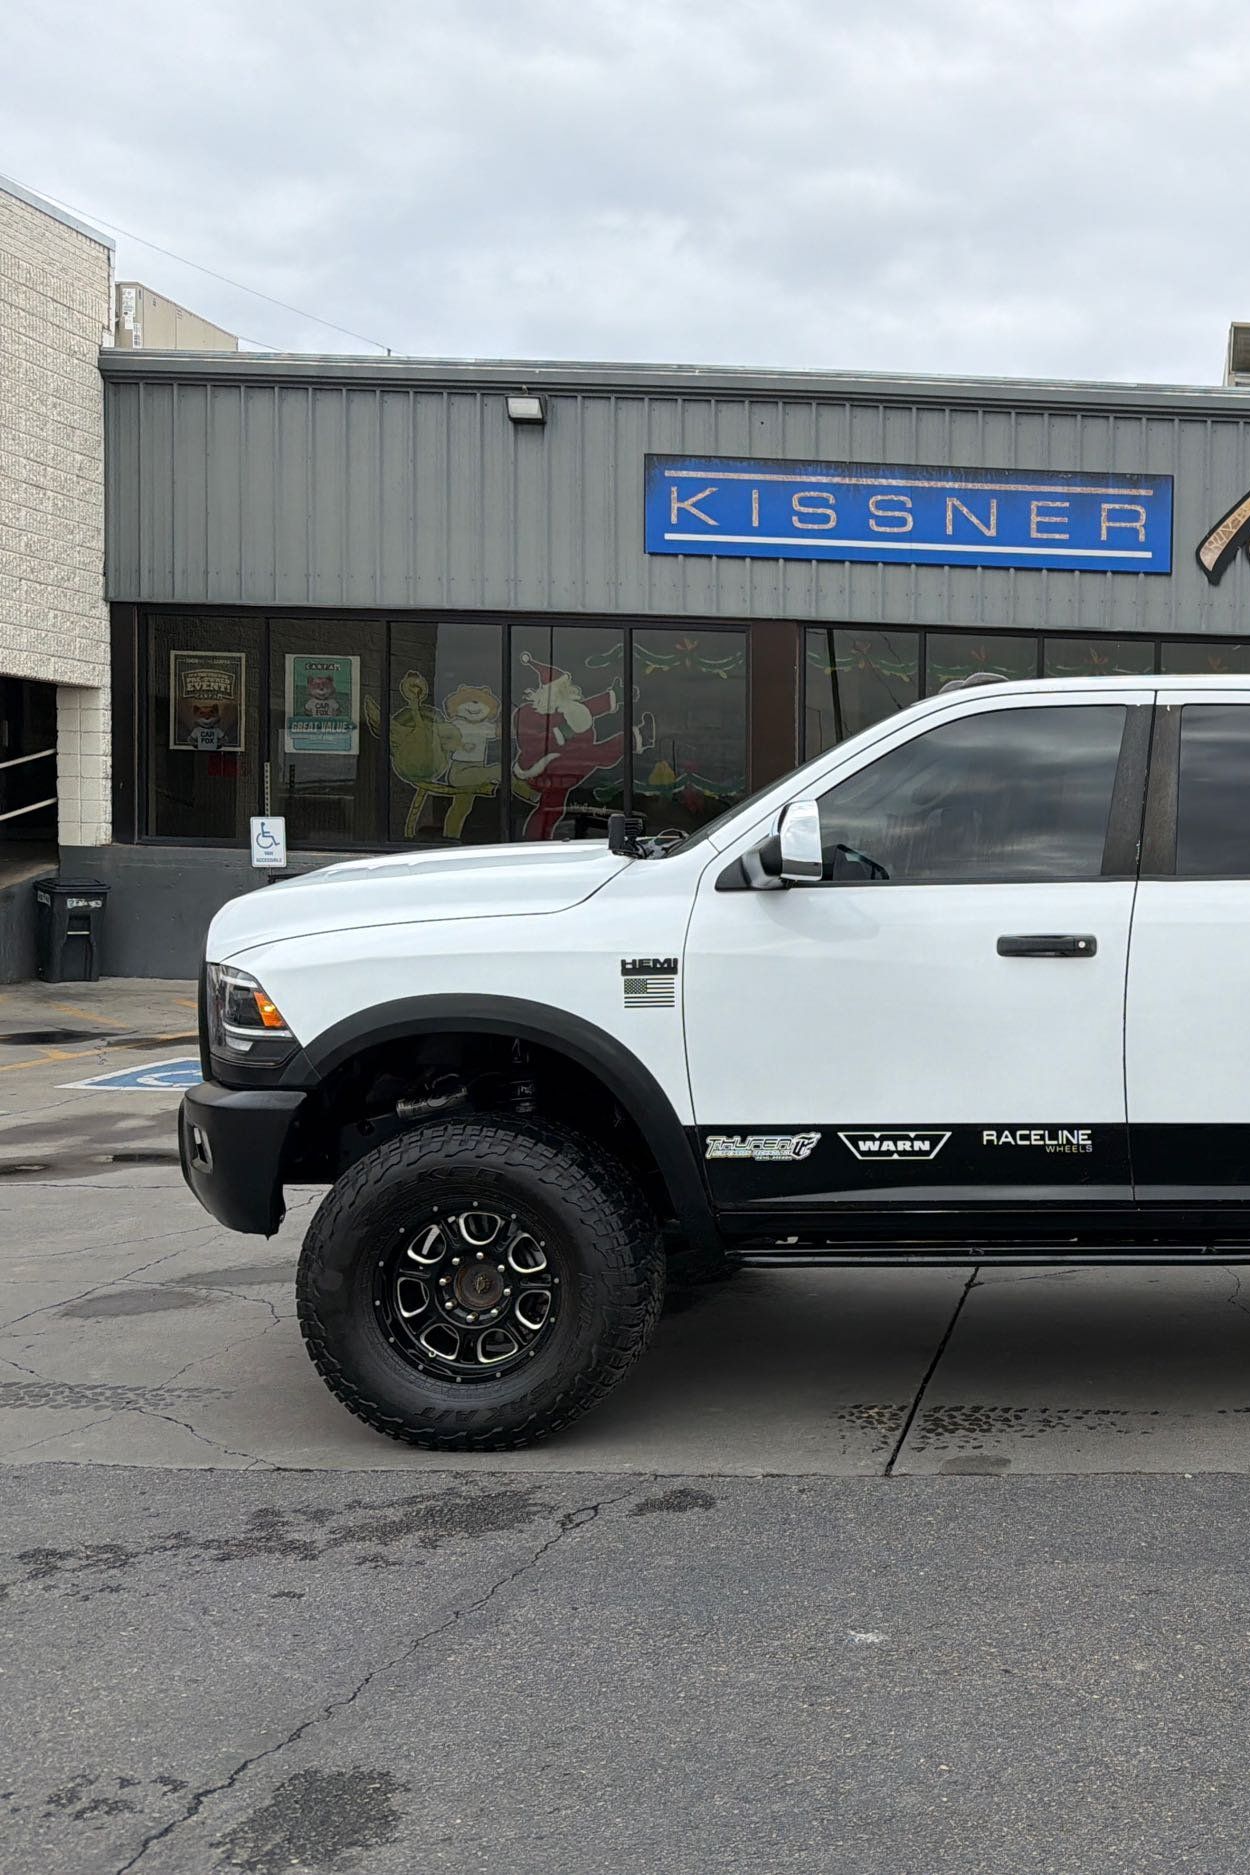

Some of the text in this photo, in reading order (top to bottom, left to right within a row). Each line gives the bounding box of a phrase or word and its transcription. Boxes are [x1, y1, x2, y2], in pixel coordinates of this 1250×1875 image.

[670, 485, 1148, 543] KISSNER
[187, 682, 230, 693] EVENT!
[291, 721, 348, 733] GREAT VALUE
[982, 1129, 1093, 1145] RACELINE
[857, 1140, 931, 1151] WARN
[1045, 1145, 1093, 1153] WHEELS
